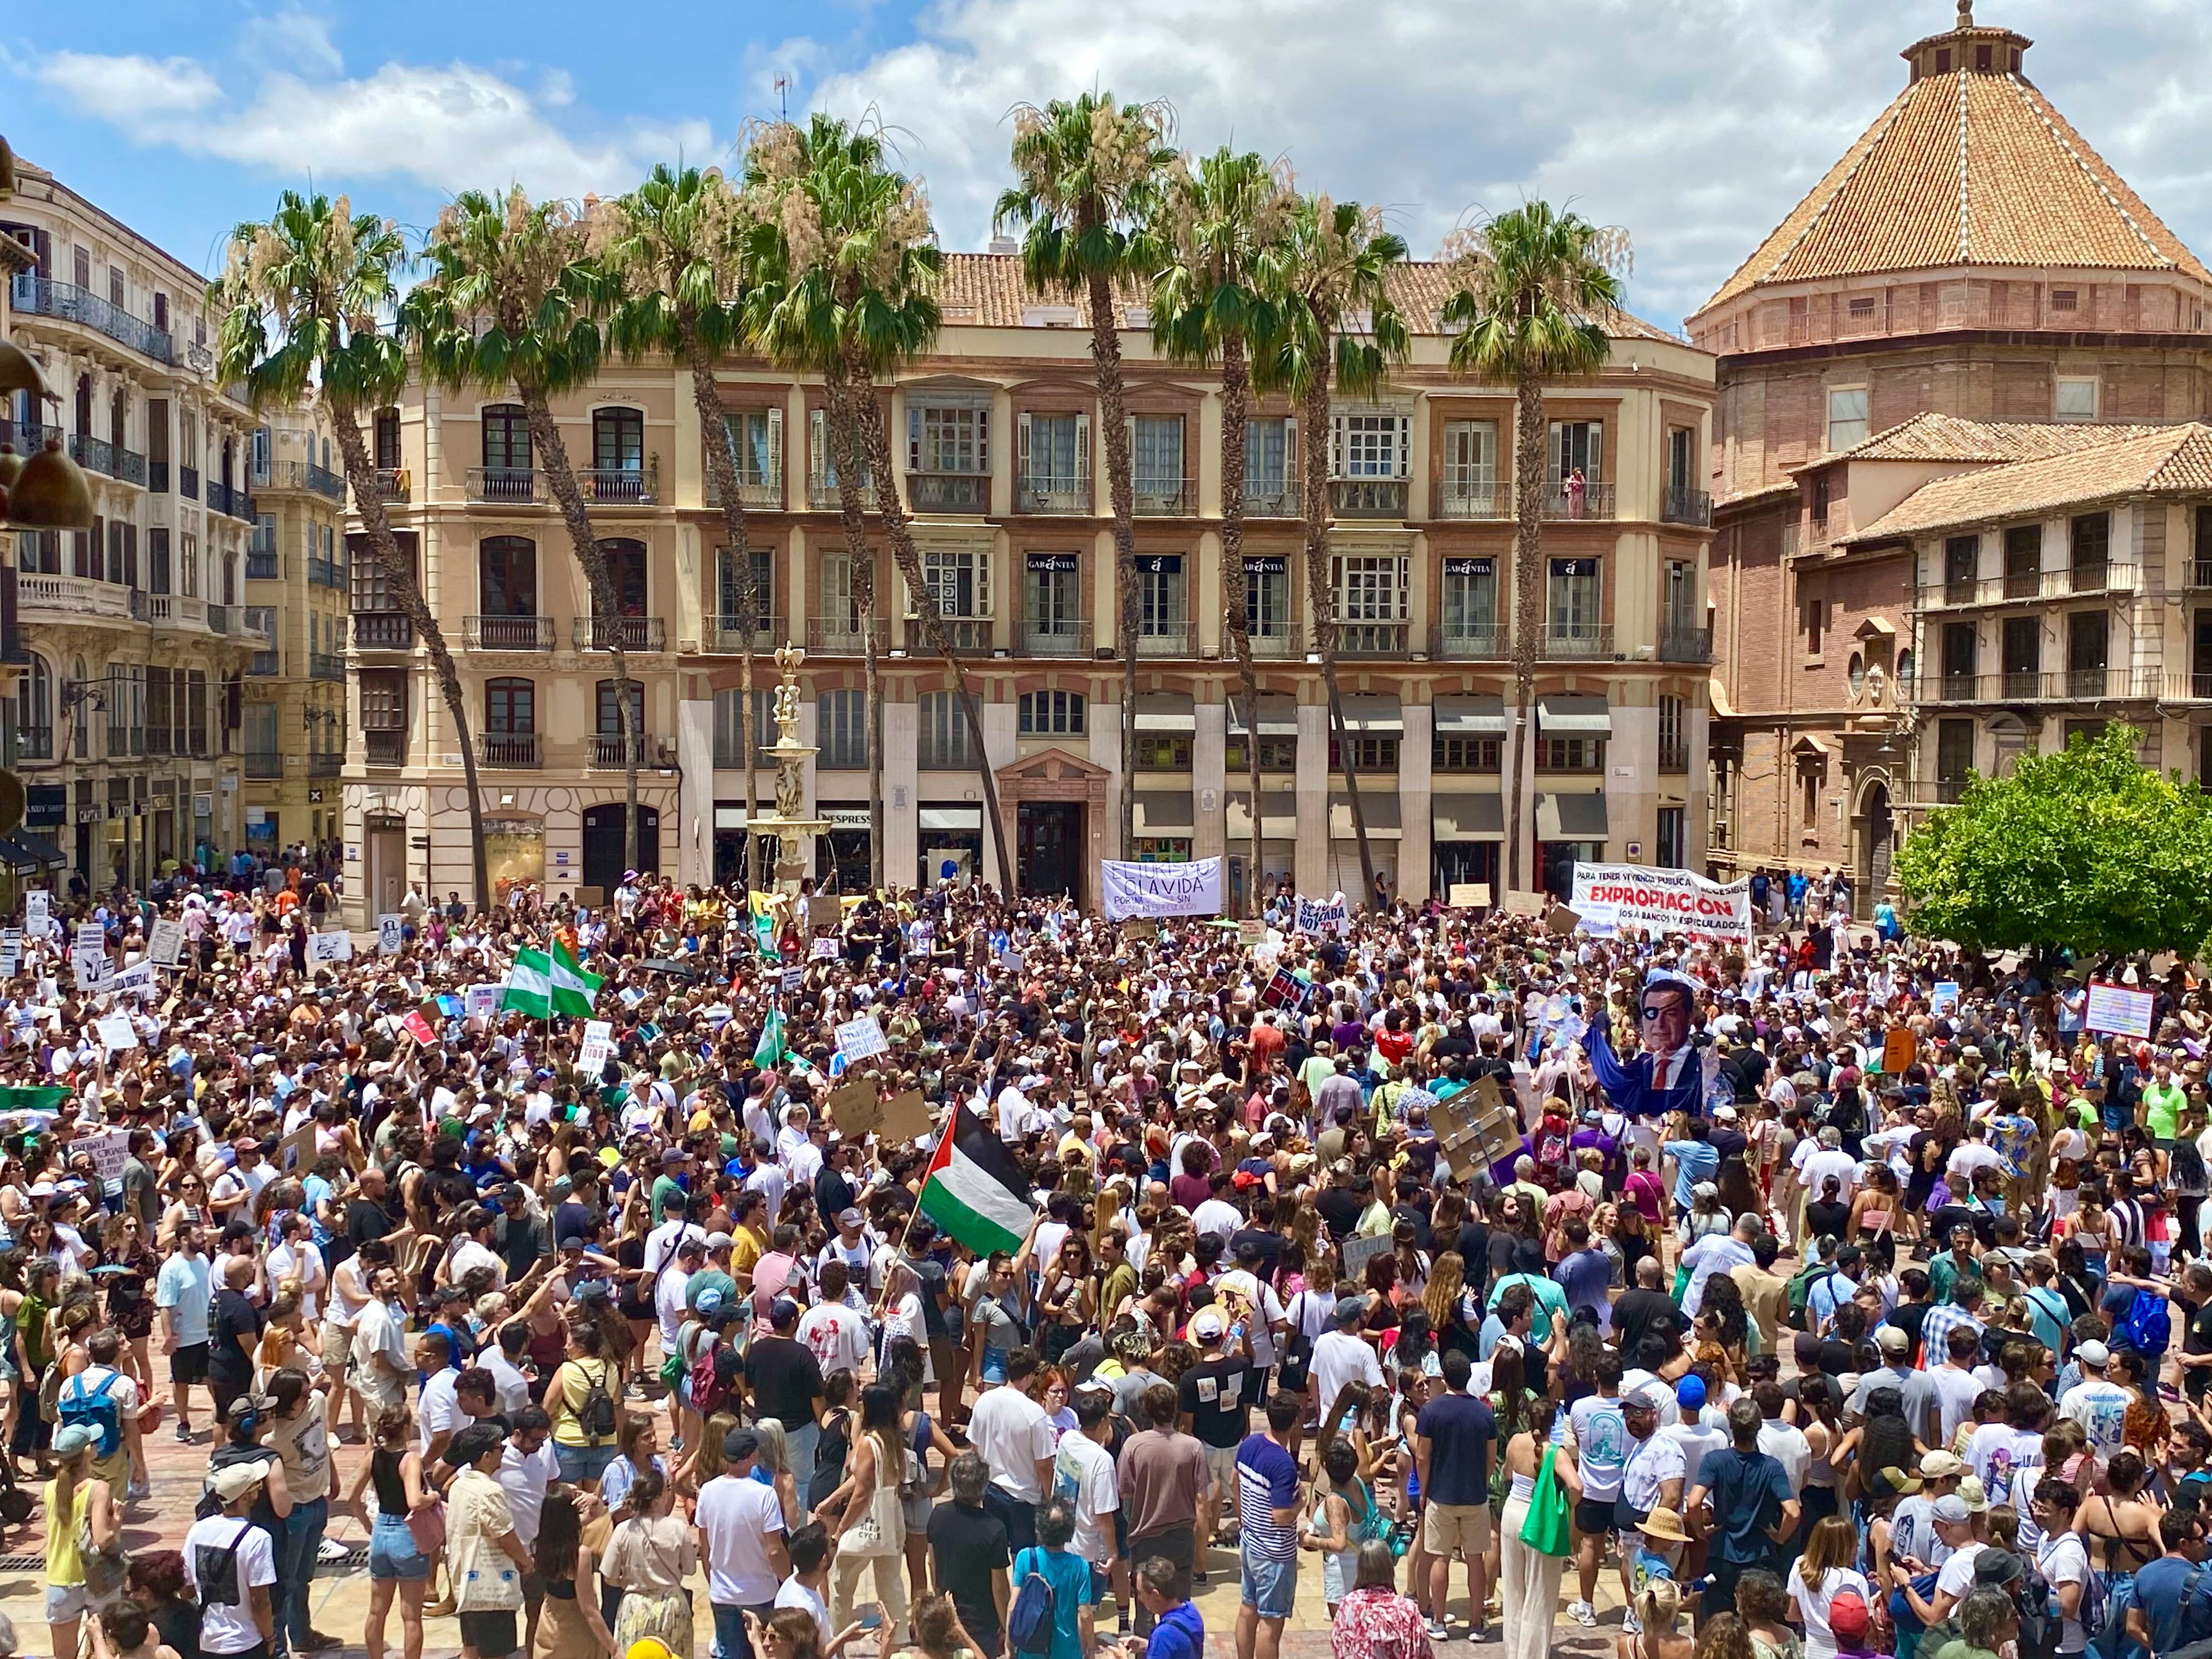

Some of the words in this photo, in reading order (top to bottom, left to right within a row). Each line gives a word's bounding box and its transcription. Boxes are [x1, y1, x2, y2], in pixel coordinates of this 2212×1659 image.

[1576, 871, 1595, 880] PARA
[1599, 873, 1620, 881] TENER
[1623, 874, 1655, 883] VIVIENDA
[1139, 880, 1159, 895] LA
[1161, 877, 1203, 895] VIDA
[1177, 895, 1191, 903] SIN
[1590, 886, 1734, 917] EXPROPIACIÓN
[1299, 915, 1319, 931] HOY
[1641, 912, 1669, 923] BANCOS
[1673, 915, 1678, 923] Y
[1679, 917, 1745, 930] ESPECULADORES
